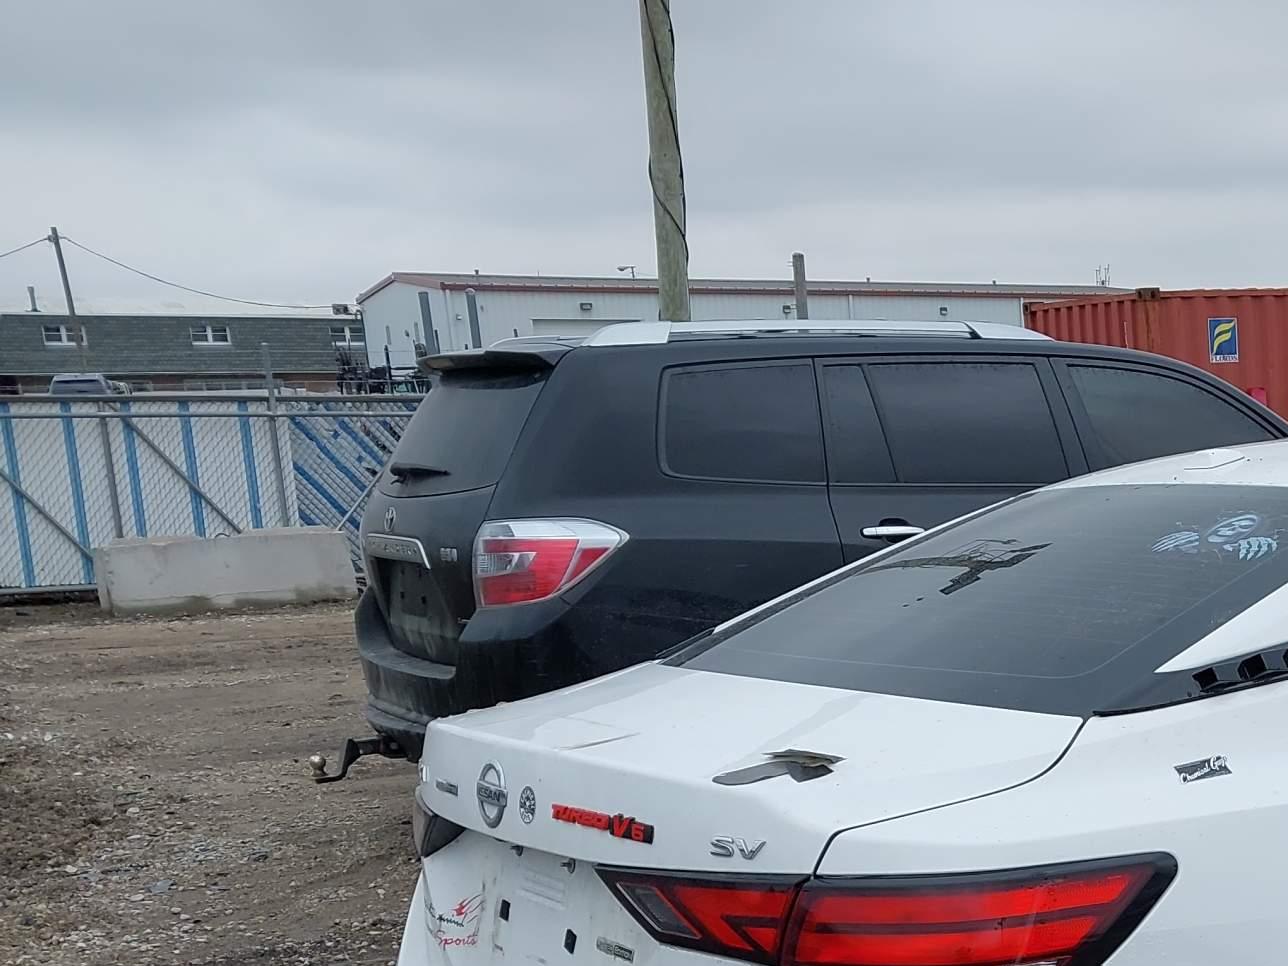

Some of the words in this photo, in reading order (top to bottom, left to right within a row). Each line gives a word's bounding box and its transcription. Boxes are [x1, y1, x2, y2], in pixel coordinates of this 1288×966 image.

[552, 804, 610, 830] TURBO
[612, 813, 645, 842] V6
[710, 835, 767, 861] SV
